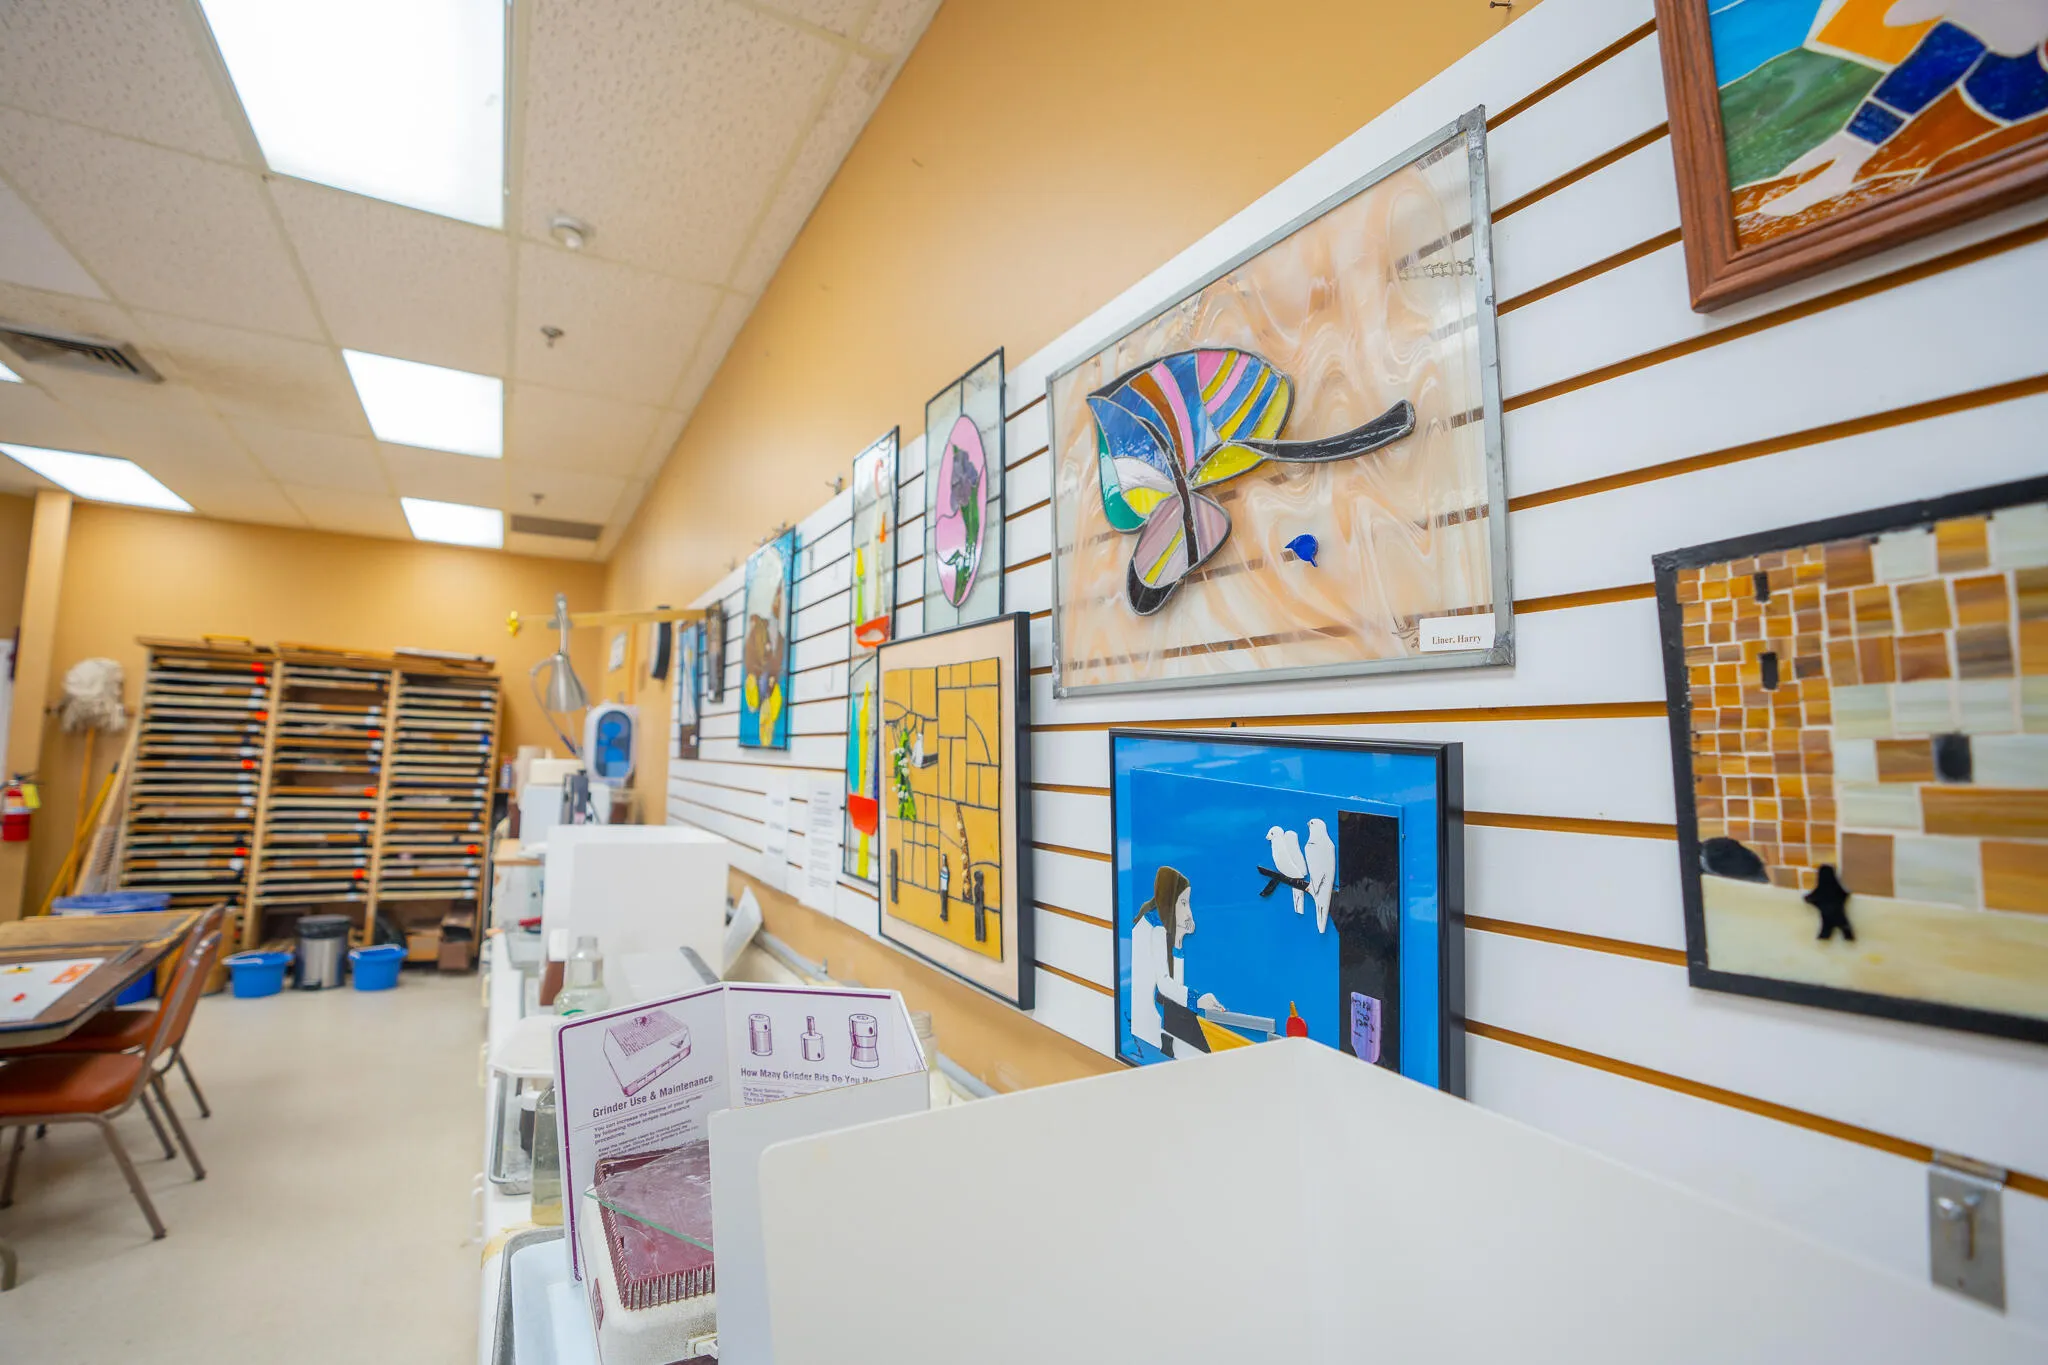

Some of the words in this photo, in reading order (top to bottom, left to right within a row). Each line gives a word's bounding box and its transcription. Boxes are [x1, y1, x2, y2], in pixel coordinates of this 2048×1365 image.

[1432, 636, 1456, 645] Liner,
[1458, 634, 1481, 644] Harry
[740, 1067, 758, 1077] How
[760, 1069, 781, 1080] Many
[783, 1070, 813, 1081] Grinder
[814, 1073, 830, 1082] Bits
[832, 1074, 844, 1083] Do
[845, 1075, 861, 1084] You
[592, 1101, 628, 1117] Grinder
[629, 1095, 647, 1107] Use
[650, 1090, 657, 1101] &
[659, 1075, 713, 1097] Maintenance
